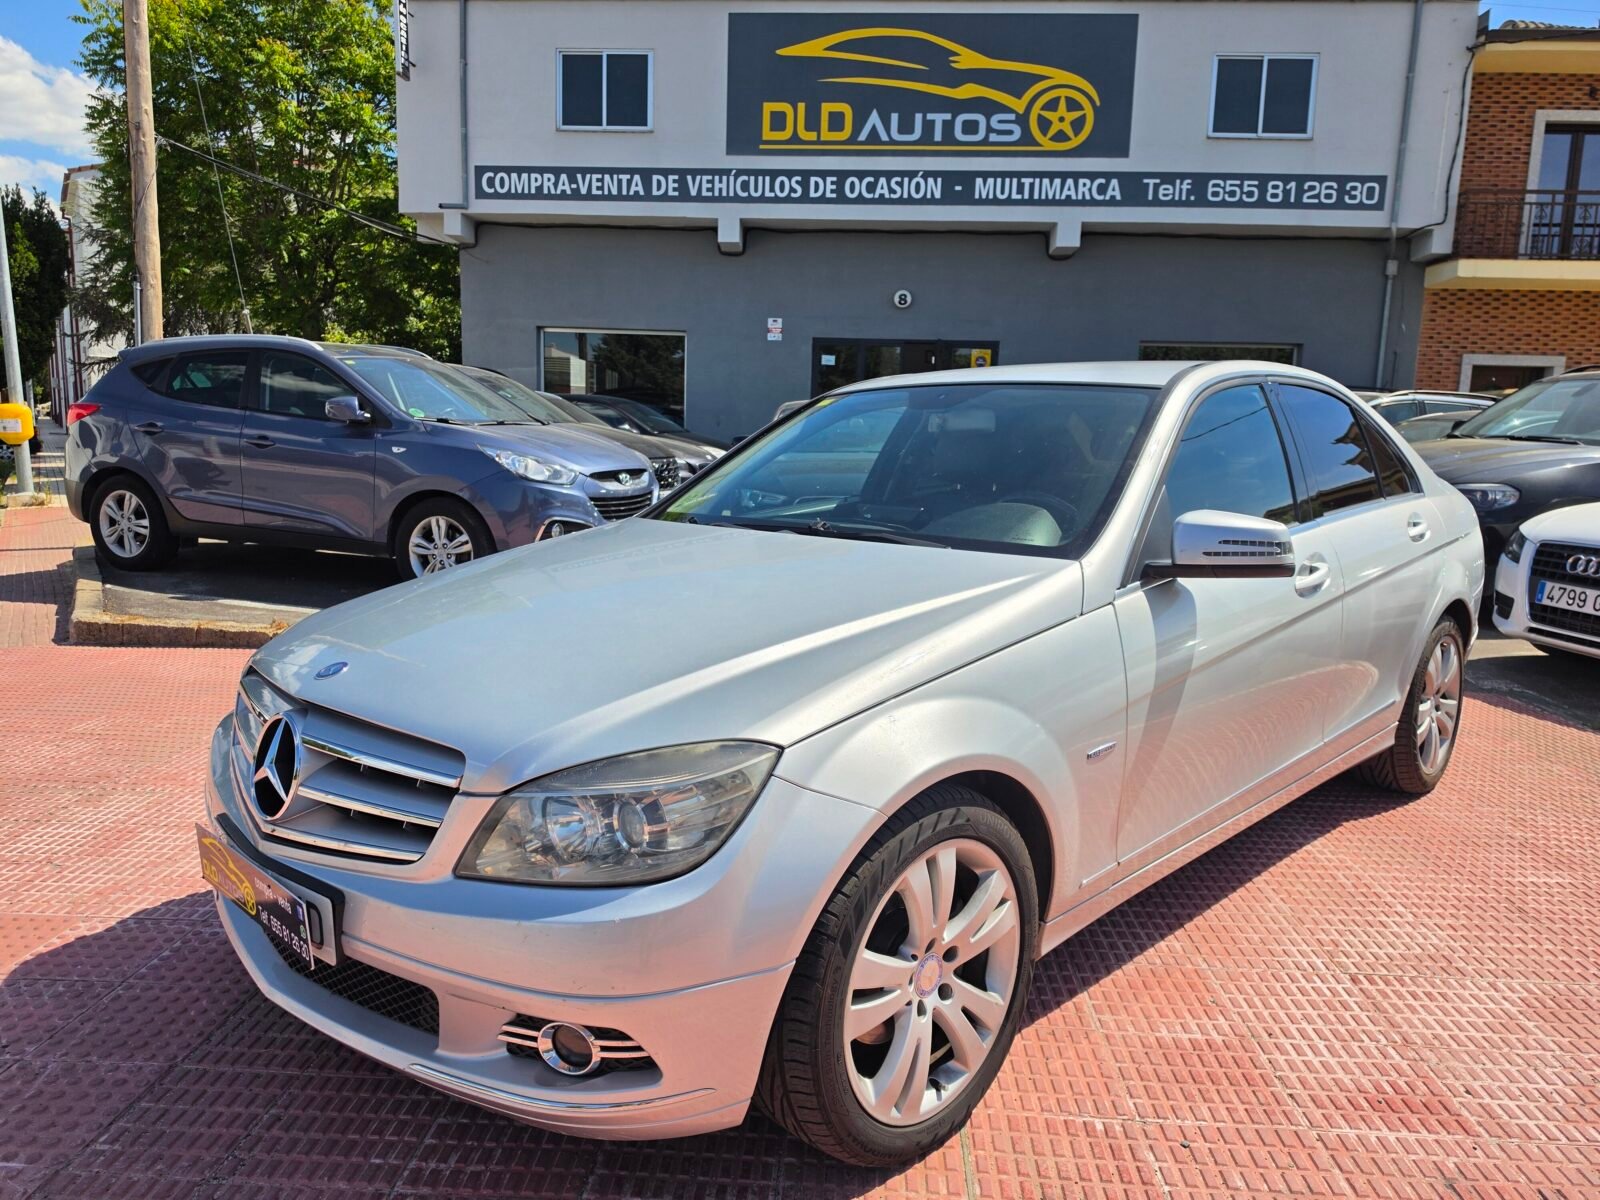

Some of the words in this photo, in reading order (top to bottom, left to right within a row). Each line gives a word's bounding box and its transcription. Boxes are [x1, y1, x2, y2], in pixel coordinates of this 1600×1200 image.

[761, 101, 853, 141] DLD
[856, 107, 1022, 142] AUTOS
[481, 171, 645, 197] COMPRA-VENTA
[651, 174, 679, 197] DE
[686, 169, 802, 198] VEHÍCULOS
[808, 175, 837, 198] DE
[844, 171, 943, 199] OCASIÓN
[973, 177, 1122, 201] MULTIMARCA
[1143, 178, 1196, 201] Telf.
[1207, 179, 1259, 202] 655
[1265, 180, 1297, 203] 81
[1302, 181, 1338, 204] 26
[1344, 181, 1380, 205] 30
[898, 293, 908, 306] 8
[1546, 585, 1588, 609] 4799
[277, 894, 292, 914] venta
[270, 915, 283, 938] 655
[282, 925, 291, 945] 81
[291, 932, 301, 953] 26
[300, 940, 310, 961] 30
